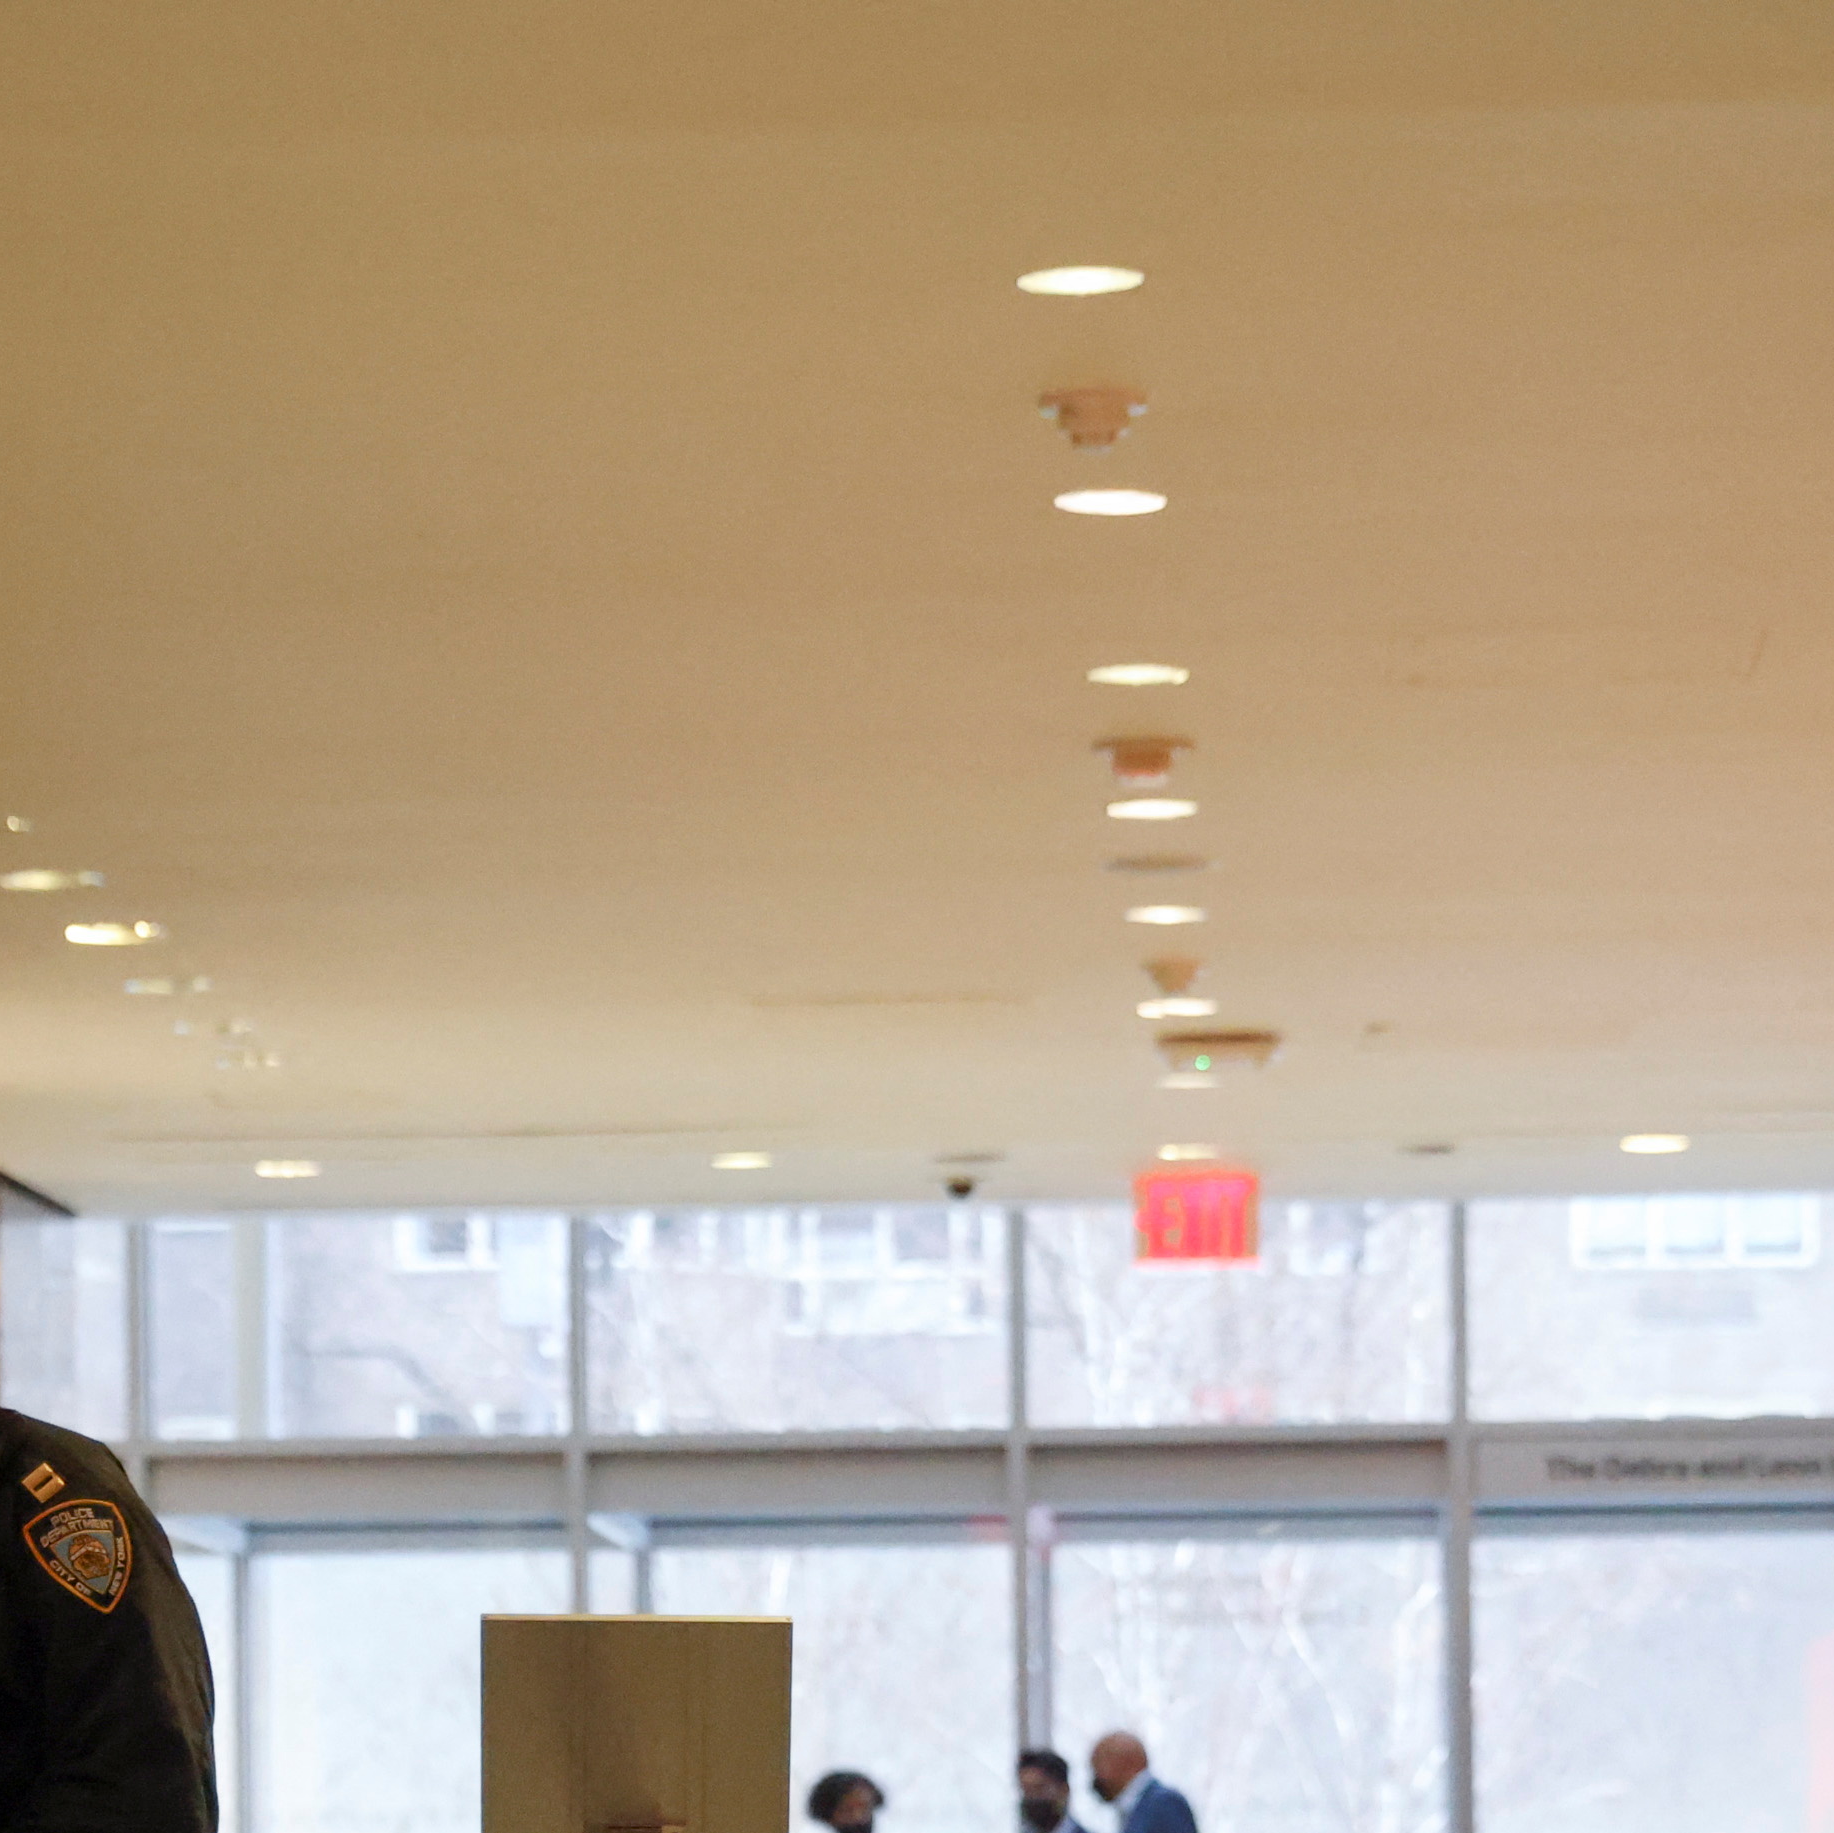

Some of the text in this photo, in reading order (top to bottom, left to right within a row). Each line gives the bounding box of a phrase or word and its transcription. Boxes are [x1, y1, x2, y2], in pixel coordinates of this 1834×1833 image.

[50, 1508, 95, 1527] POLICE
[40, 1519, 115, 1548] DEPARTMENT
[49, 1559, 76, 1582] CITY
